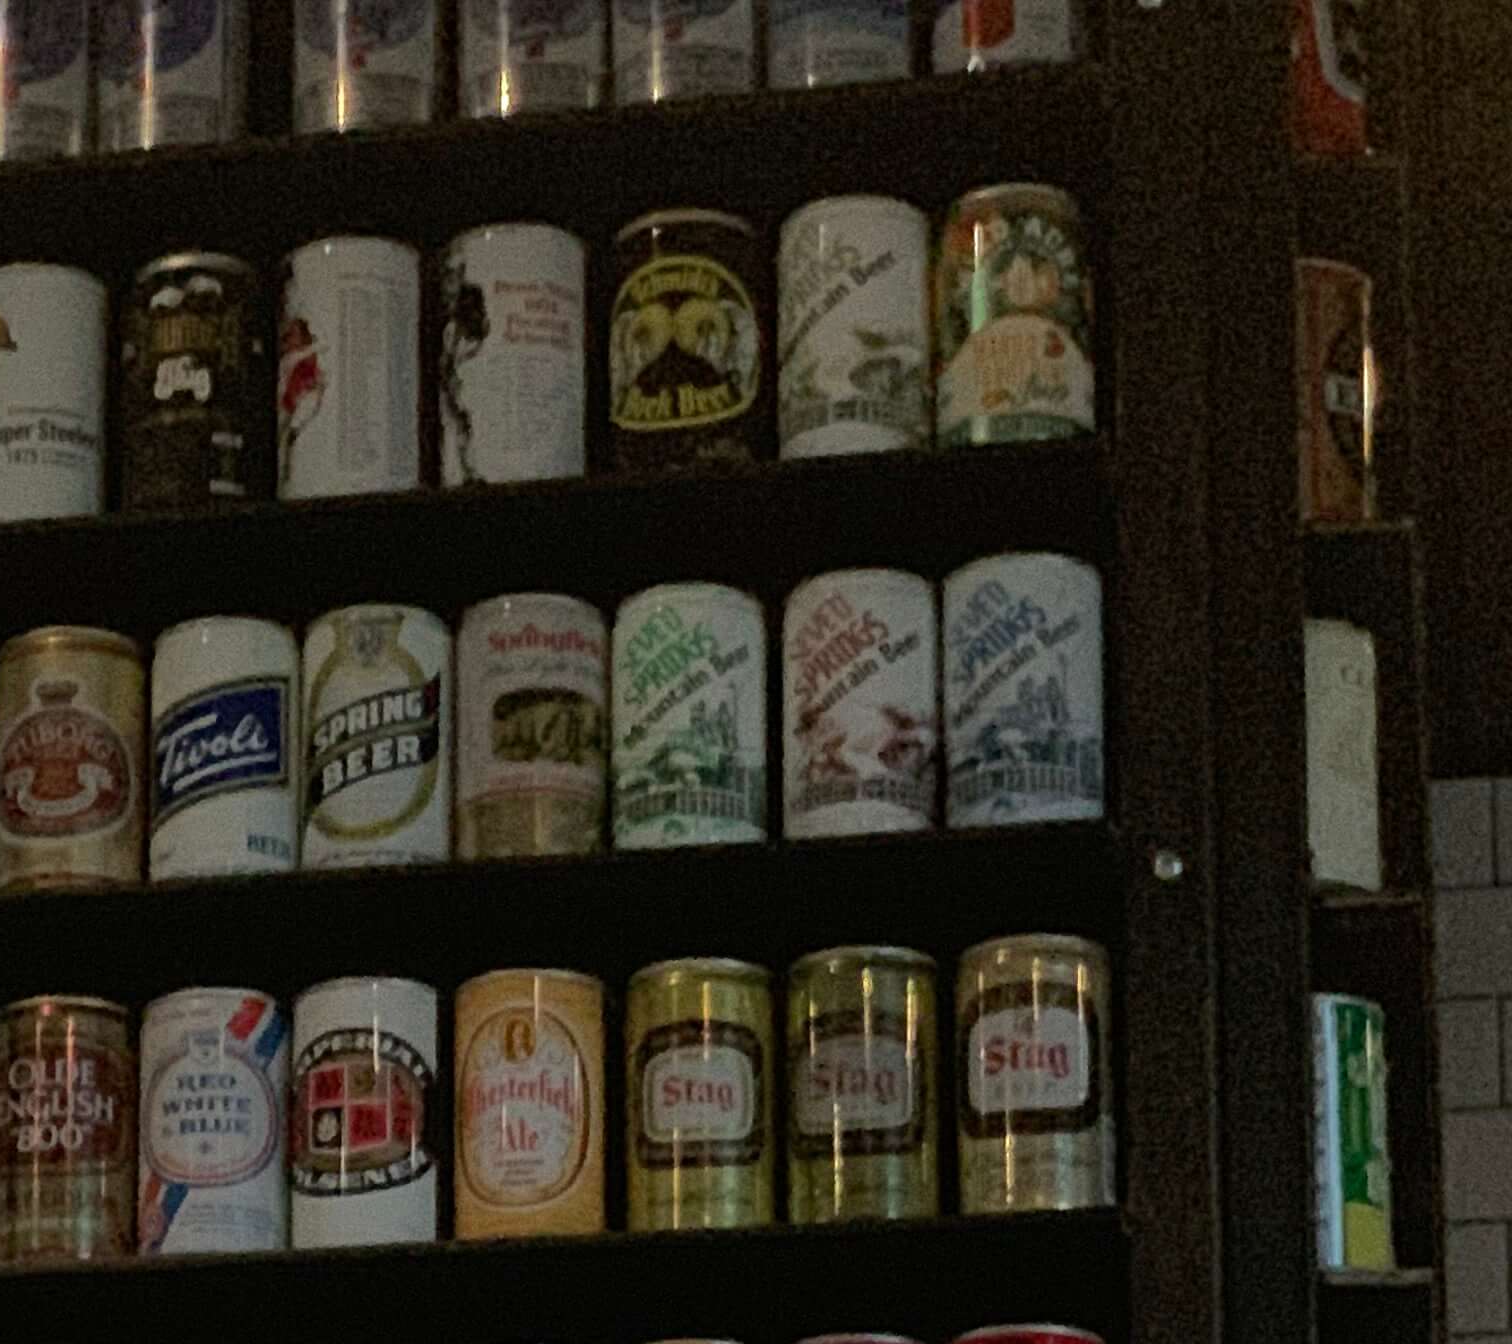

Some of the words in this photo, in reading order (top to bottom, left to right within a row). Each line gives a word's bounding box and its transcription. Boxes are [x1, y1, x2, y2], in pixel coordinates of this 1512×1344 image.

[315, 693, 425, 757] SPRING
[157, 713, 269, 789] Tivoli
[322, 735, 420, 797] BEER
[8, 1058, 97, 1091] OLDE
[984, 1036, 1070, 1080] Stag
[176, 1073, 236, 1091] RED
[661, 1078, 736, 1110] Stag
[809, 1062, 899, 1102] Stag
[162, 1097, 252, 1116] WHITE
[178, 1118, 250, 1137] BLUE
[497, 1118, 539, 1153] Ale
